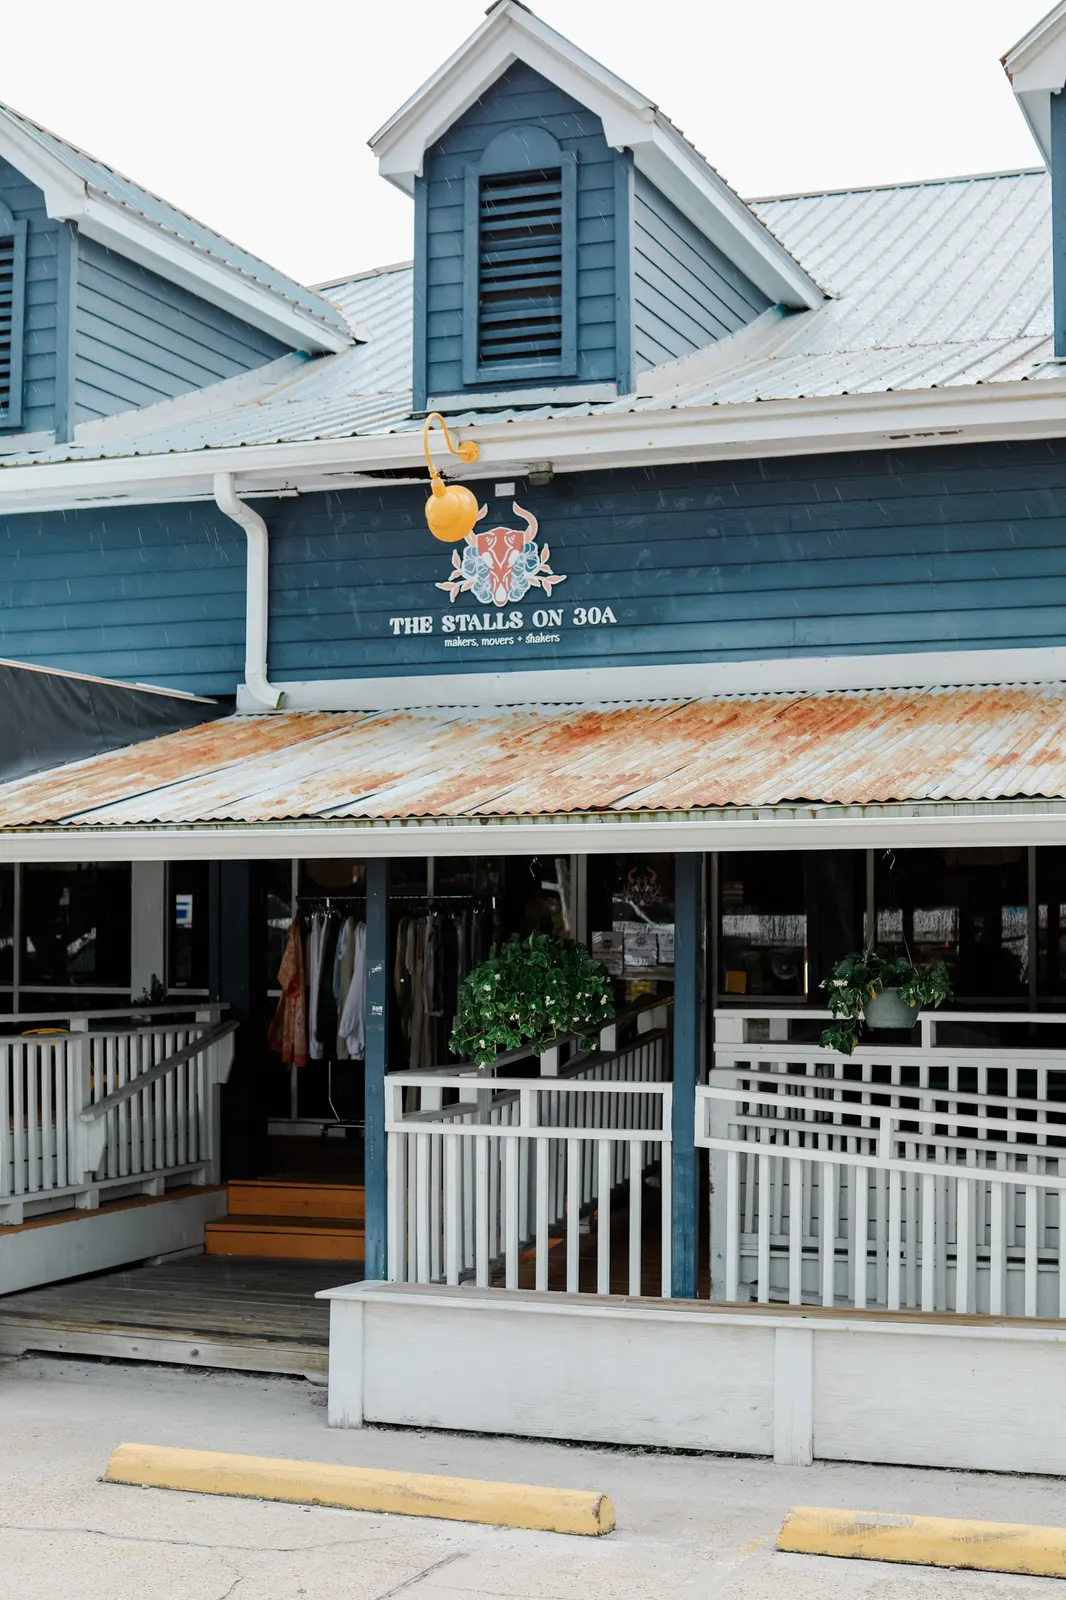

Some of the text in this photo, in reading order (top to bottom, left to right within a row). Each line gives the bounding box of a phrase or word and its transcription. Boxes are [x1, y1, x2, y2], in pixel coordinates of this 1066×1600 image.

[389, 606, 617, 635] THE STALLS ON 30A
[444, 636, 479, 648] makers,
[482, 635, 514, 646] movers
[525, 632, 560, 644] shakers
